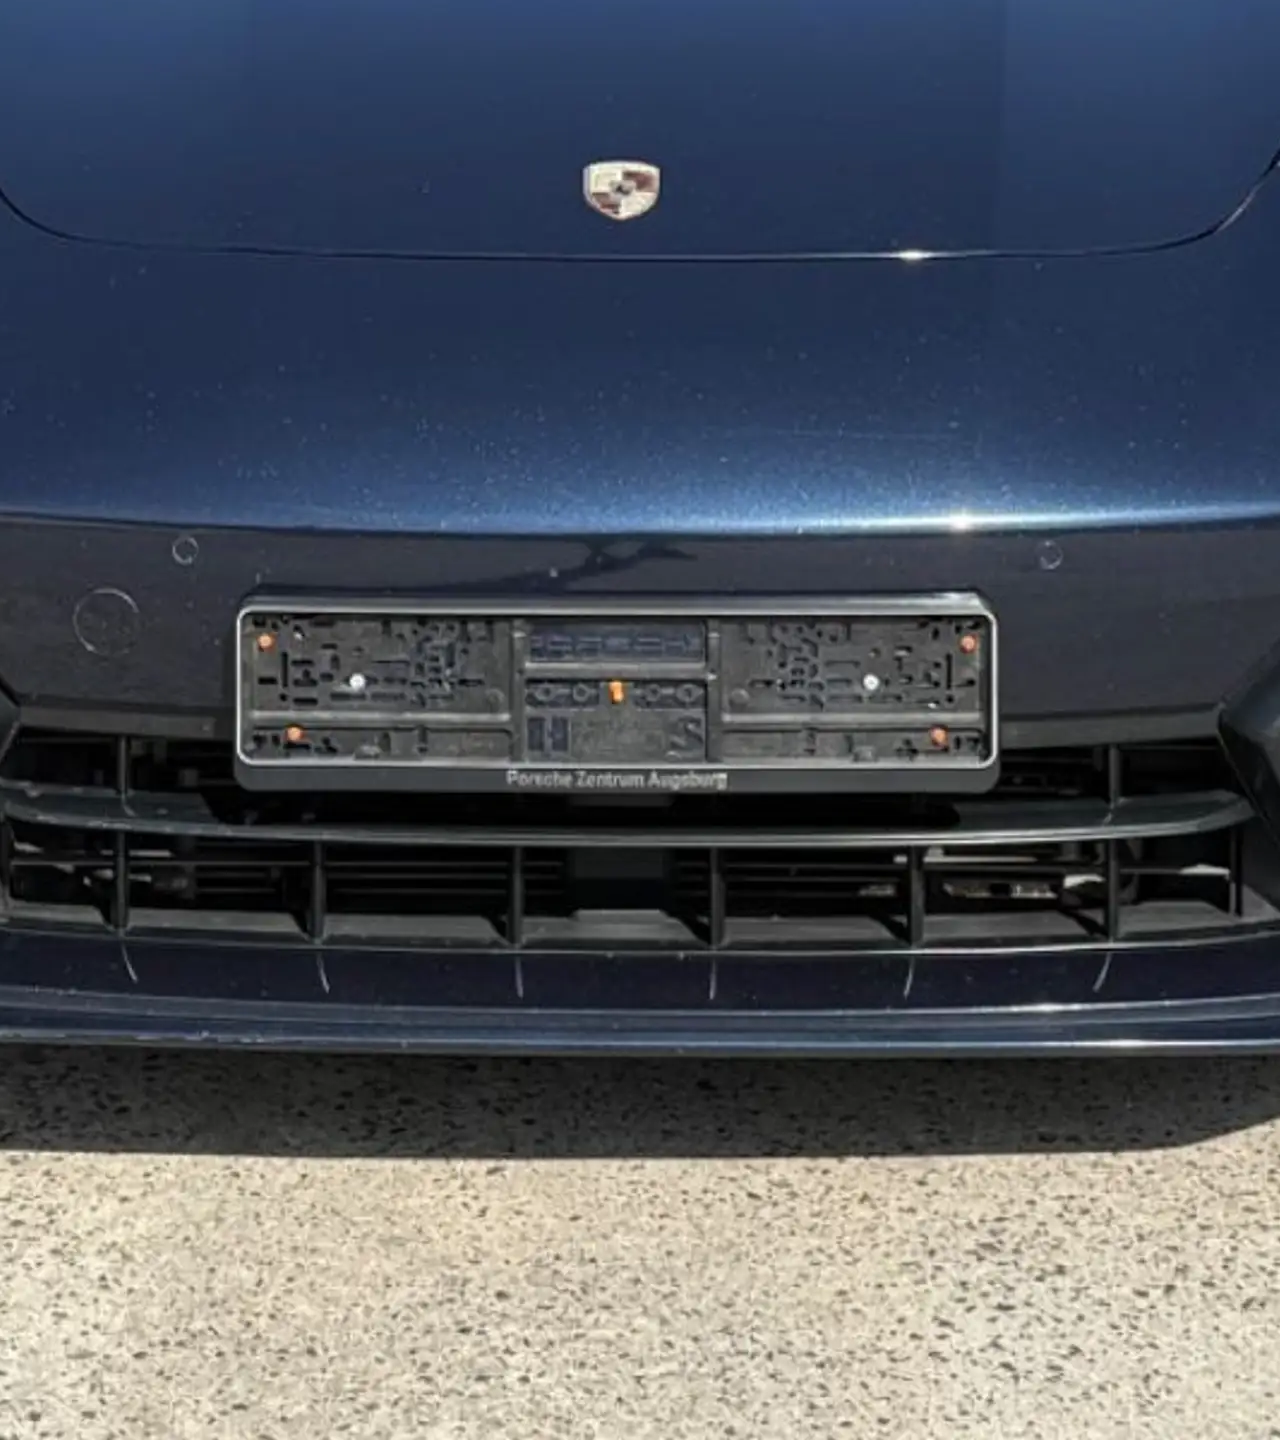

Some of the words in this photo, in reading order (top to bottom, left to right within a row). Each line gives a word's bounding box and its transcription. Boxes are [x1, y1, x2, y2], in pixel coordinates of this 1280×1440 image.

[506, 770, 571, 788] Porsche
[577, 770, 643, 788] Zentrum
[648, 770, 727, 791] Augsburg
